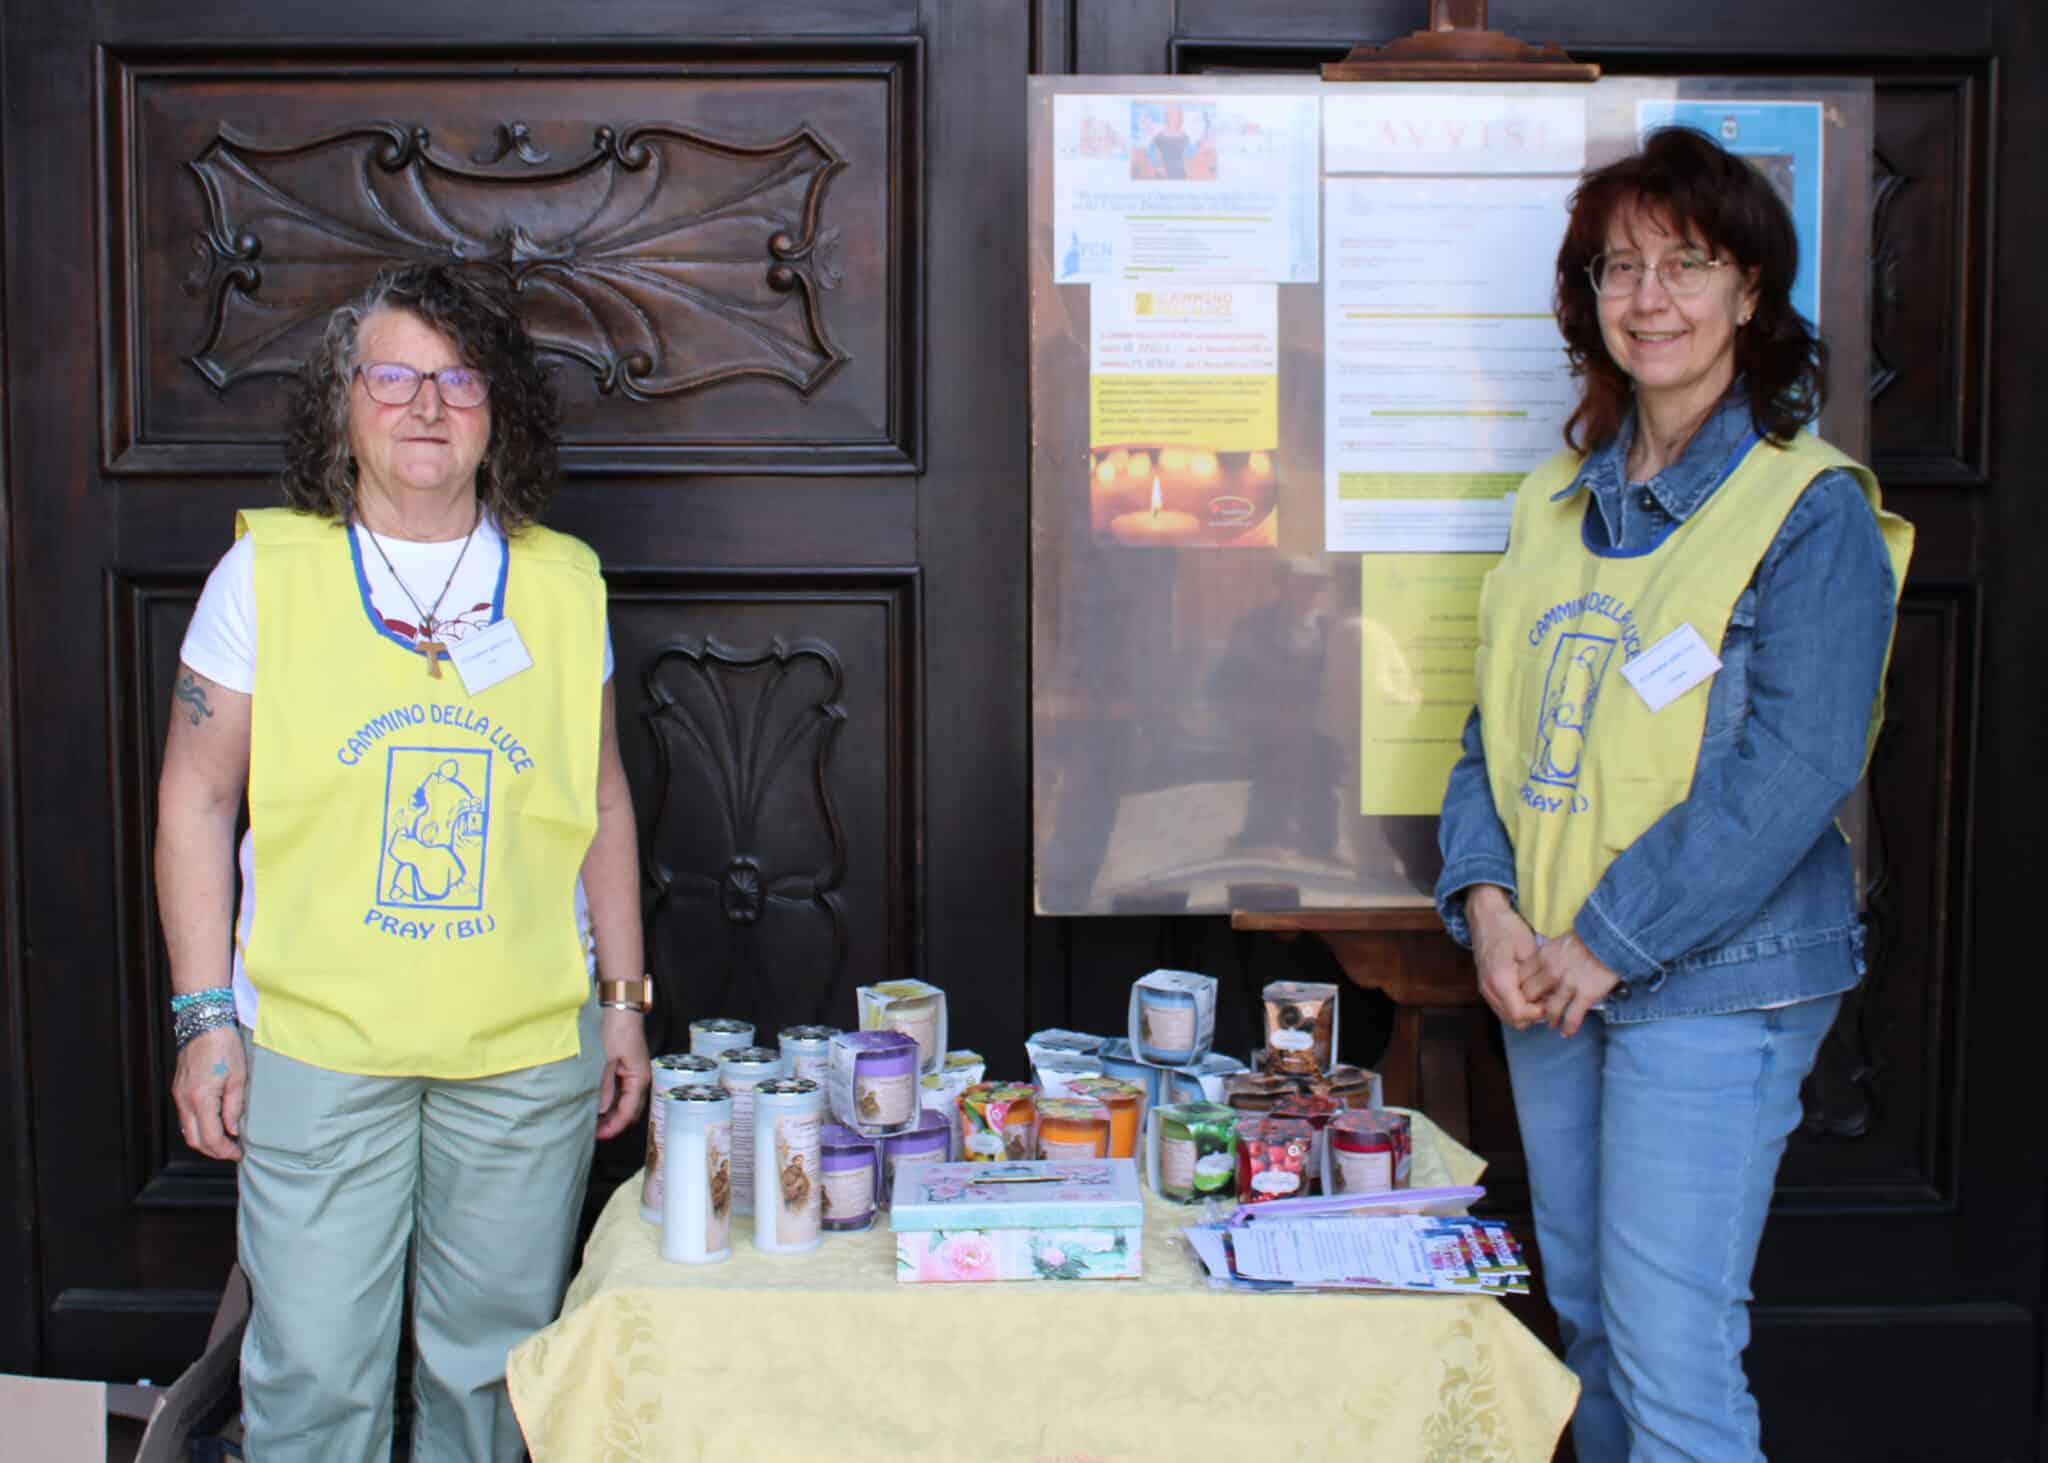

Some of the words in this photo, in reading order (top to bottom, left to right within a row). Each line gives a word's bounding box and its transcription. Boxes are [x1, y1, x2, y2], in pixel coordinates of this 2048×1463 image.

[1377, 119, 1551, 150] AVVISI
[1528, 598, 1587, 646] CAMMIN
[337, 703, 426, 766] CAMMINO
[429, 703, 491, 735] DELLA
[489, 726, 536, 775] LUCE
[363, 908, 436, 940] PRAY
[445, 914, 496, 940] (BI)
